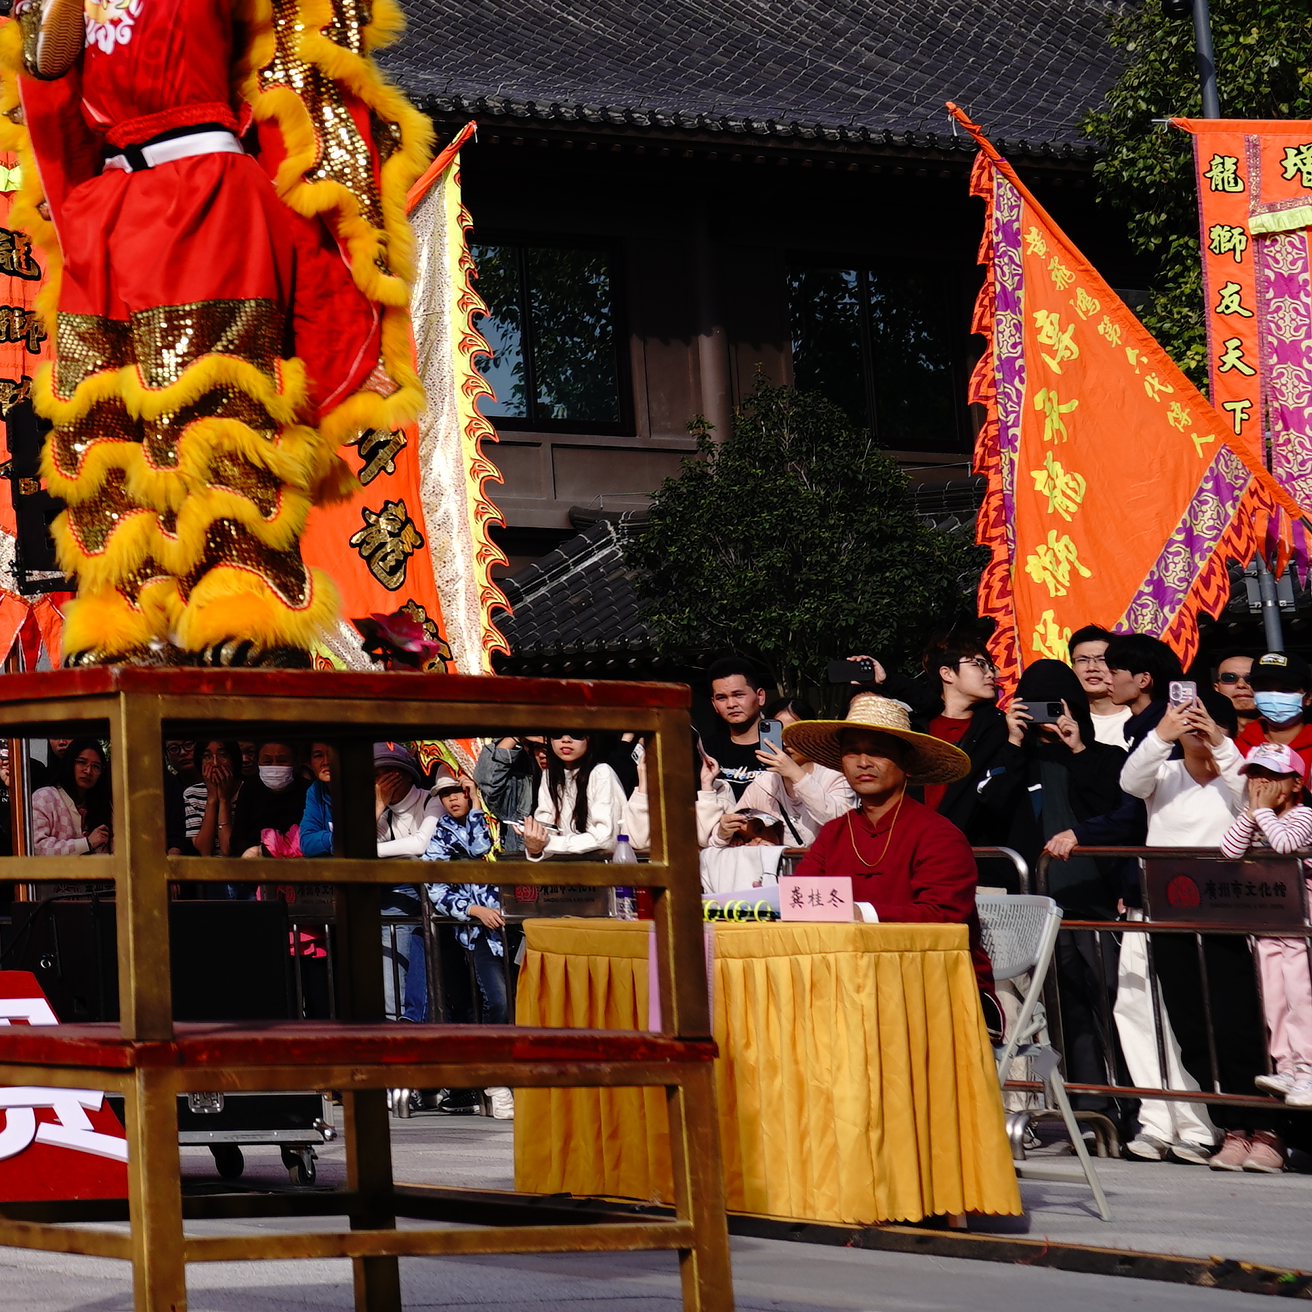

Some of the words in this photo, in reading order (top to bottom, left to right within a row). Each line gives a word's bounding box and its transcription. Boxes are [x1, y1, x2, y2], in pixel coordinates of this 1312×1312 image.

[1204, 154, 1256, 435] 龍獅友天下
